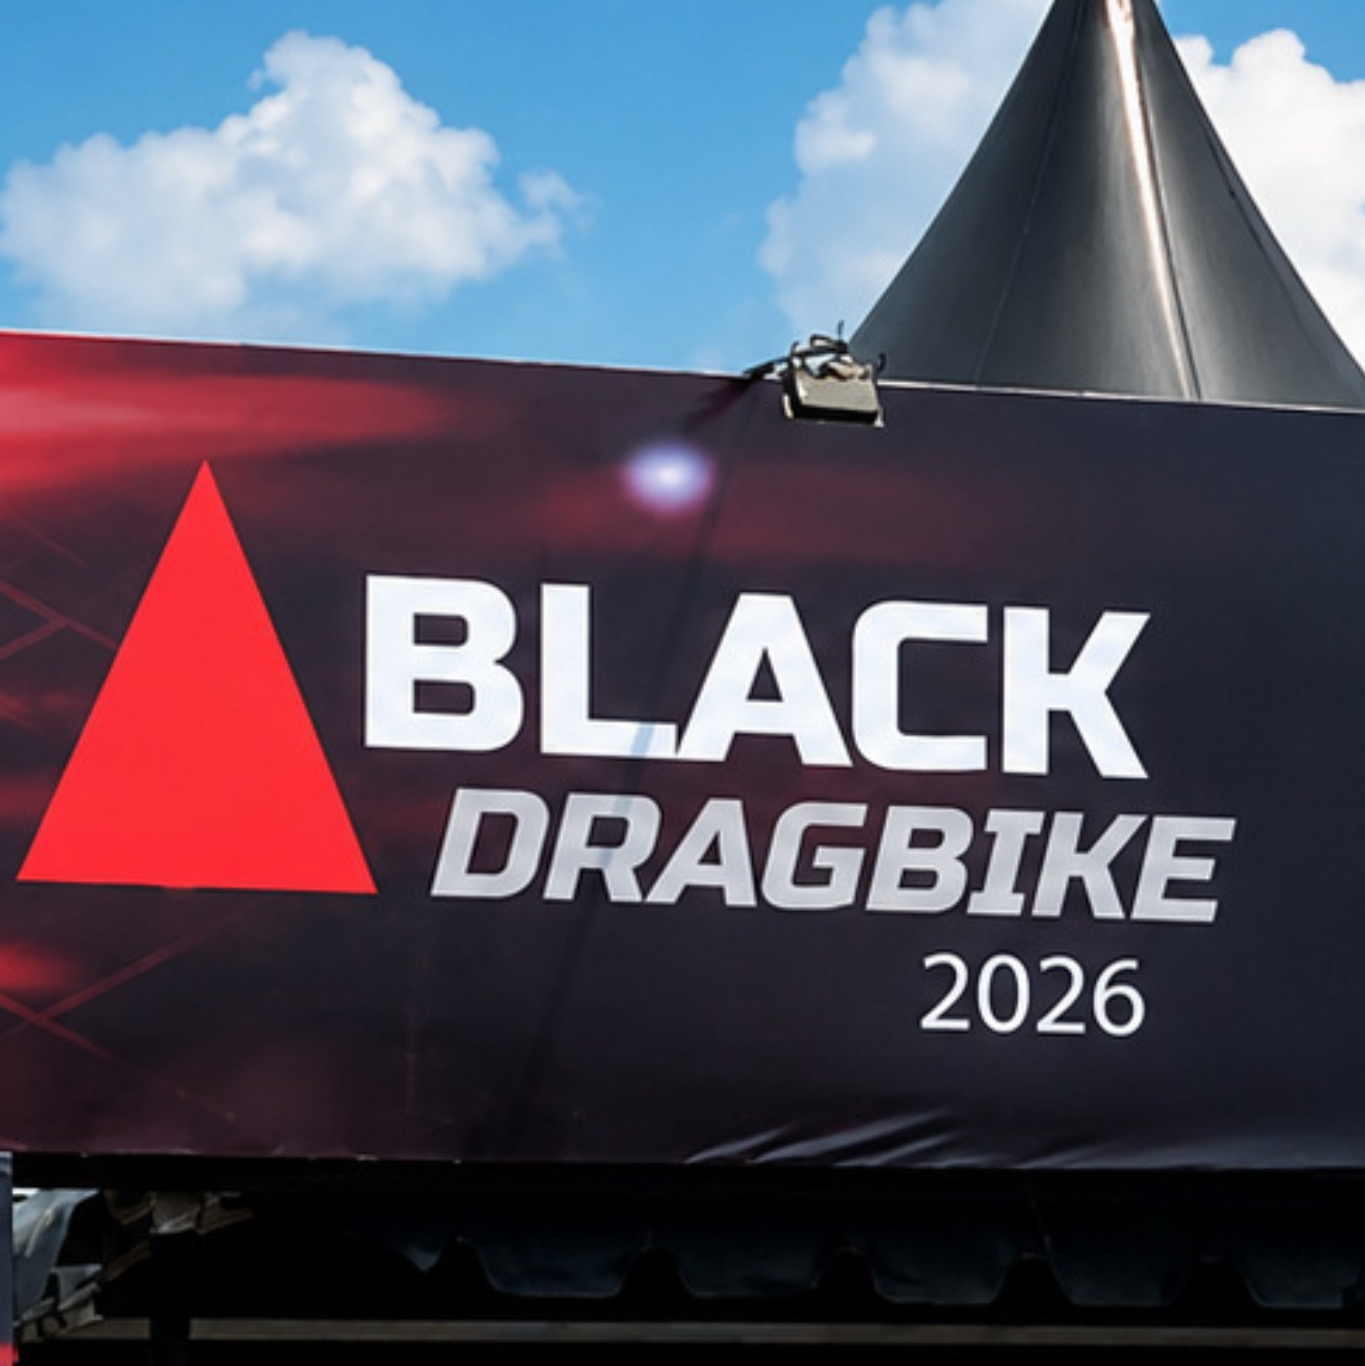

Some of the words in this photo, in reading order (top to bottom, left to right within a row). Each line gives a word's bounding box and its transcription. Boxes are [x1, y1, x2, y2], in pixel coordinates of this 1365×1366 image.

[365, 574, 1151, 778] BLACK
[431, 788, 1235, 922] DRAGBIKE
[919, 953, 1145, 1035] 2026
